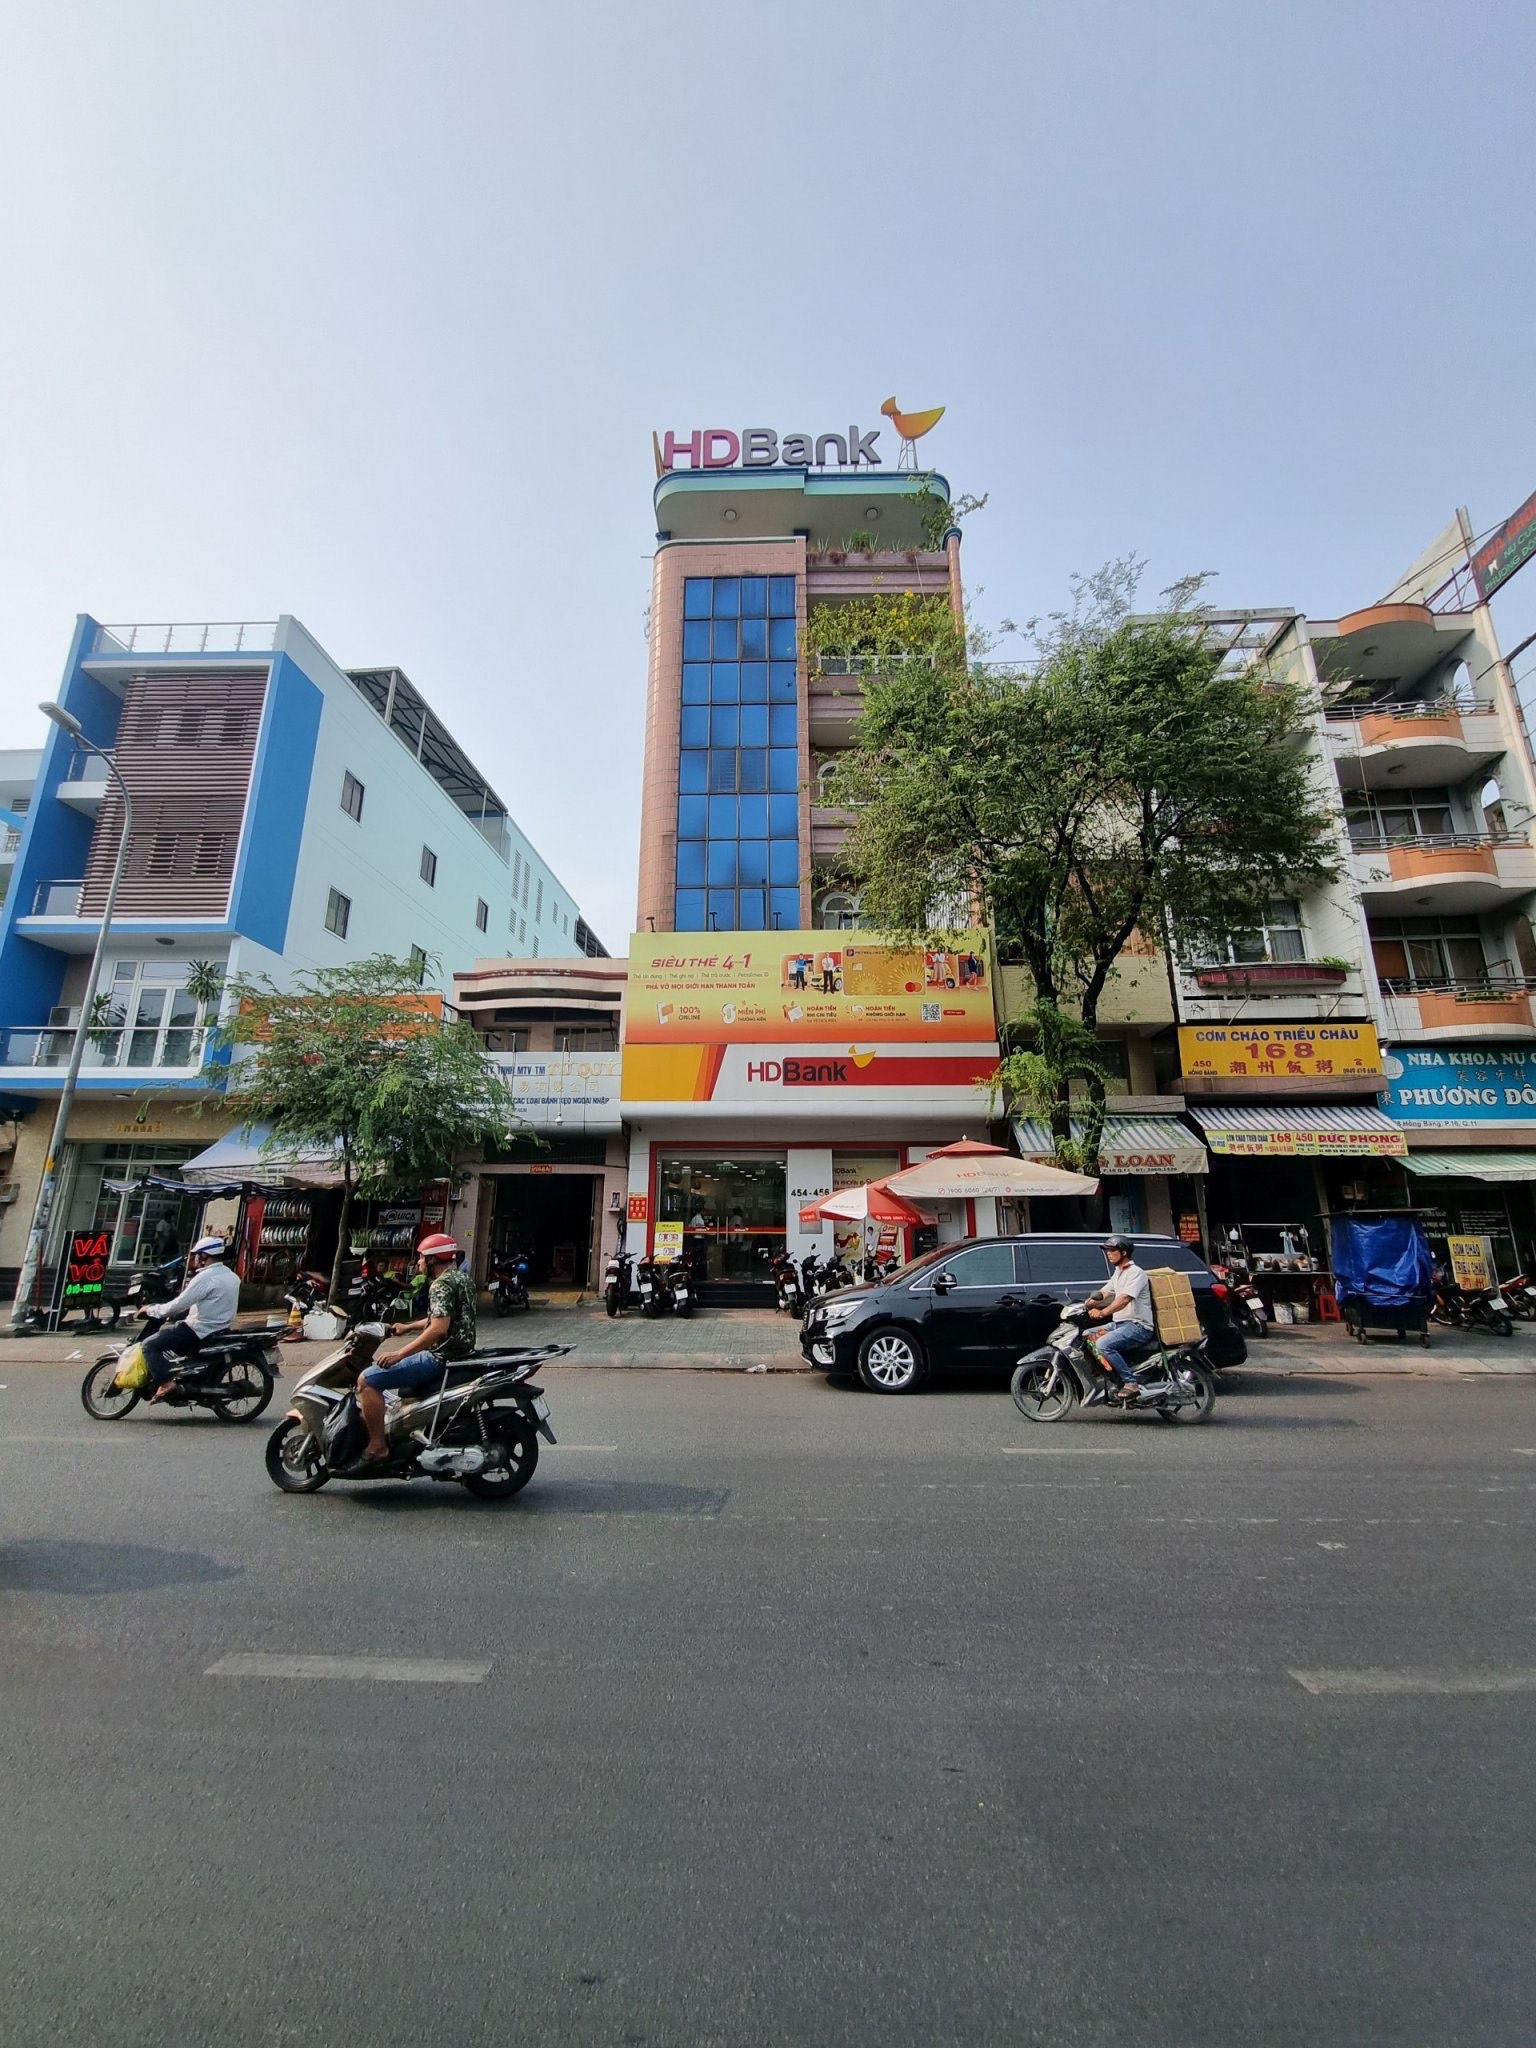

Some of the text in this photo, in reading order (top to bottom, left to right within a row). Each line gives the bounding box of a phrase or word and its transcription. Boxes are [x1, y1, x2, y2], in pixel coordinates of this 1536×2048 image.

[663, 425, 881, 468] HDBank
[651, 955, 686, 968] SIÊU
[689, 954, 719, 967] THẺ
[671, 983, 684, 991] MỌI
[738, 981, 756, 989] TOÁN
[680, 1006, 700, 1014] 100%
[738, 1006, 766, 1015] MIỄN PHÍ
[1196, 1026, 1358, 1042] CƠM CHÁO TRIỀU CHÂU
[1246, 1043, 1315, 1059] 168
[1407, 1053, 1445, 1066] NHA
[1449, 1053, 1498, 1066] KHOA
[517, 1065, 532, 1075] MTV
[535, 1066, 546, 1075] TM
[747, 1061, 848, 1082] HDBank
[526, 1097, 540, 1106] LOẠI
[541, 1096, 558, 1105] BÁNH
[1398, 1085, 1498, 1106] PHƯƠNG
[1270, 1132, 1292, 1143] 168
[1296, 1133, 1313, 1142] 450
[1349, 1134, 1400, 1143] PHONG
[1113, 1154, 1174, 1168] LOAN
[75, 1234, 108, 1257] VÁ
